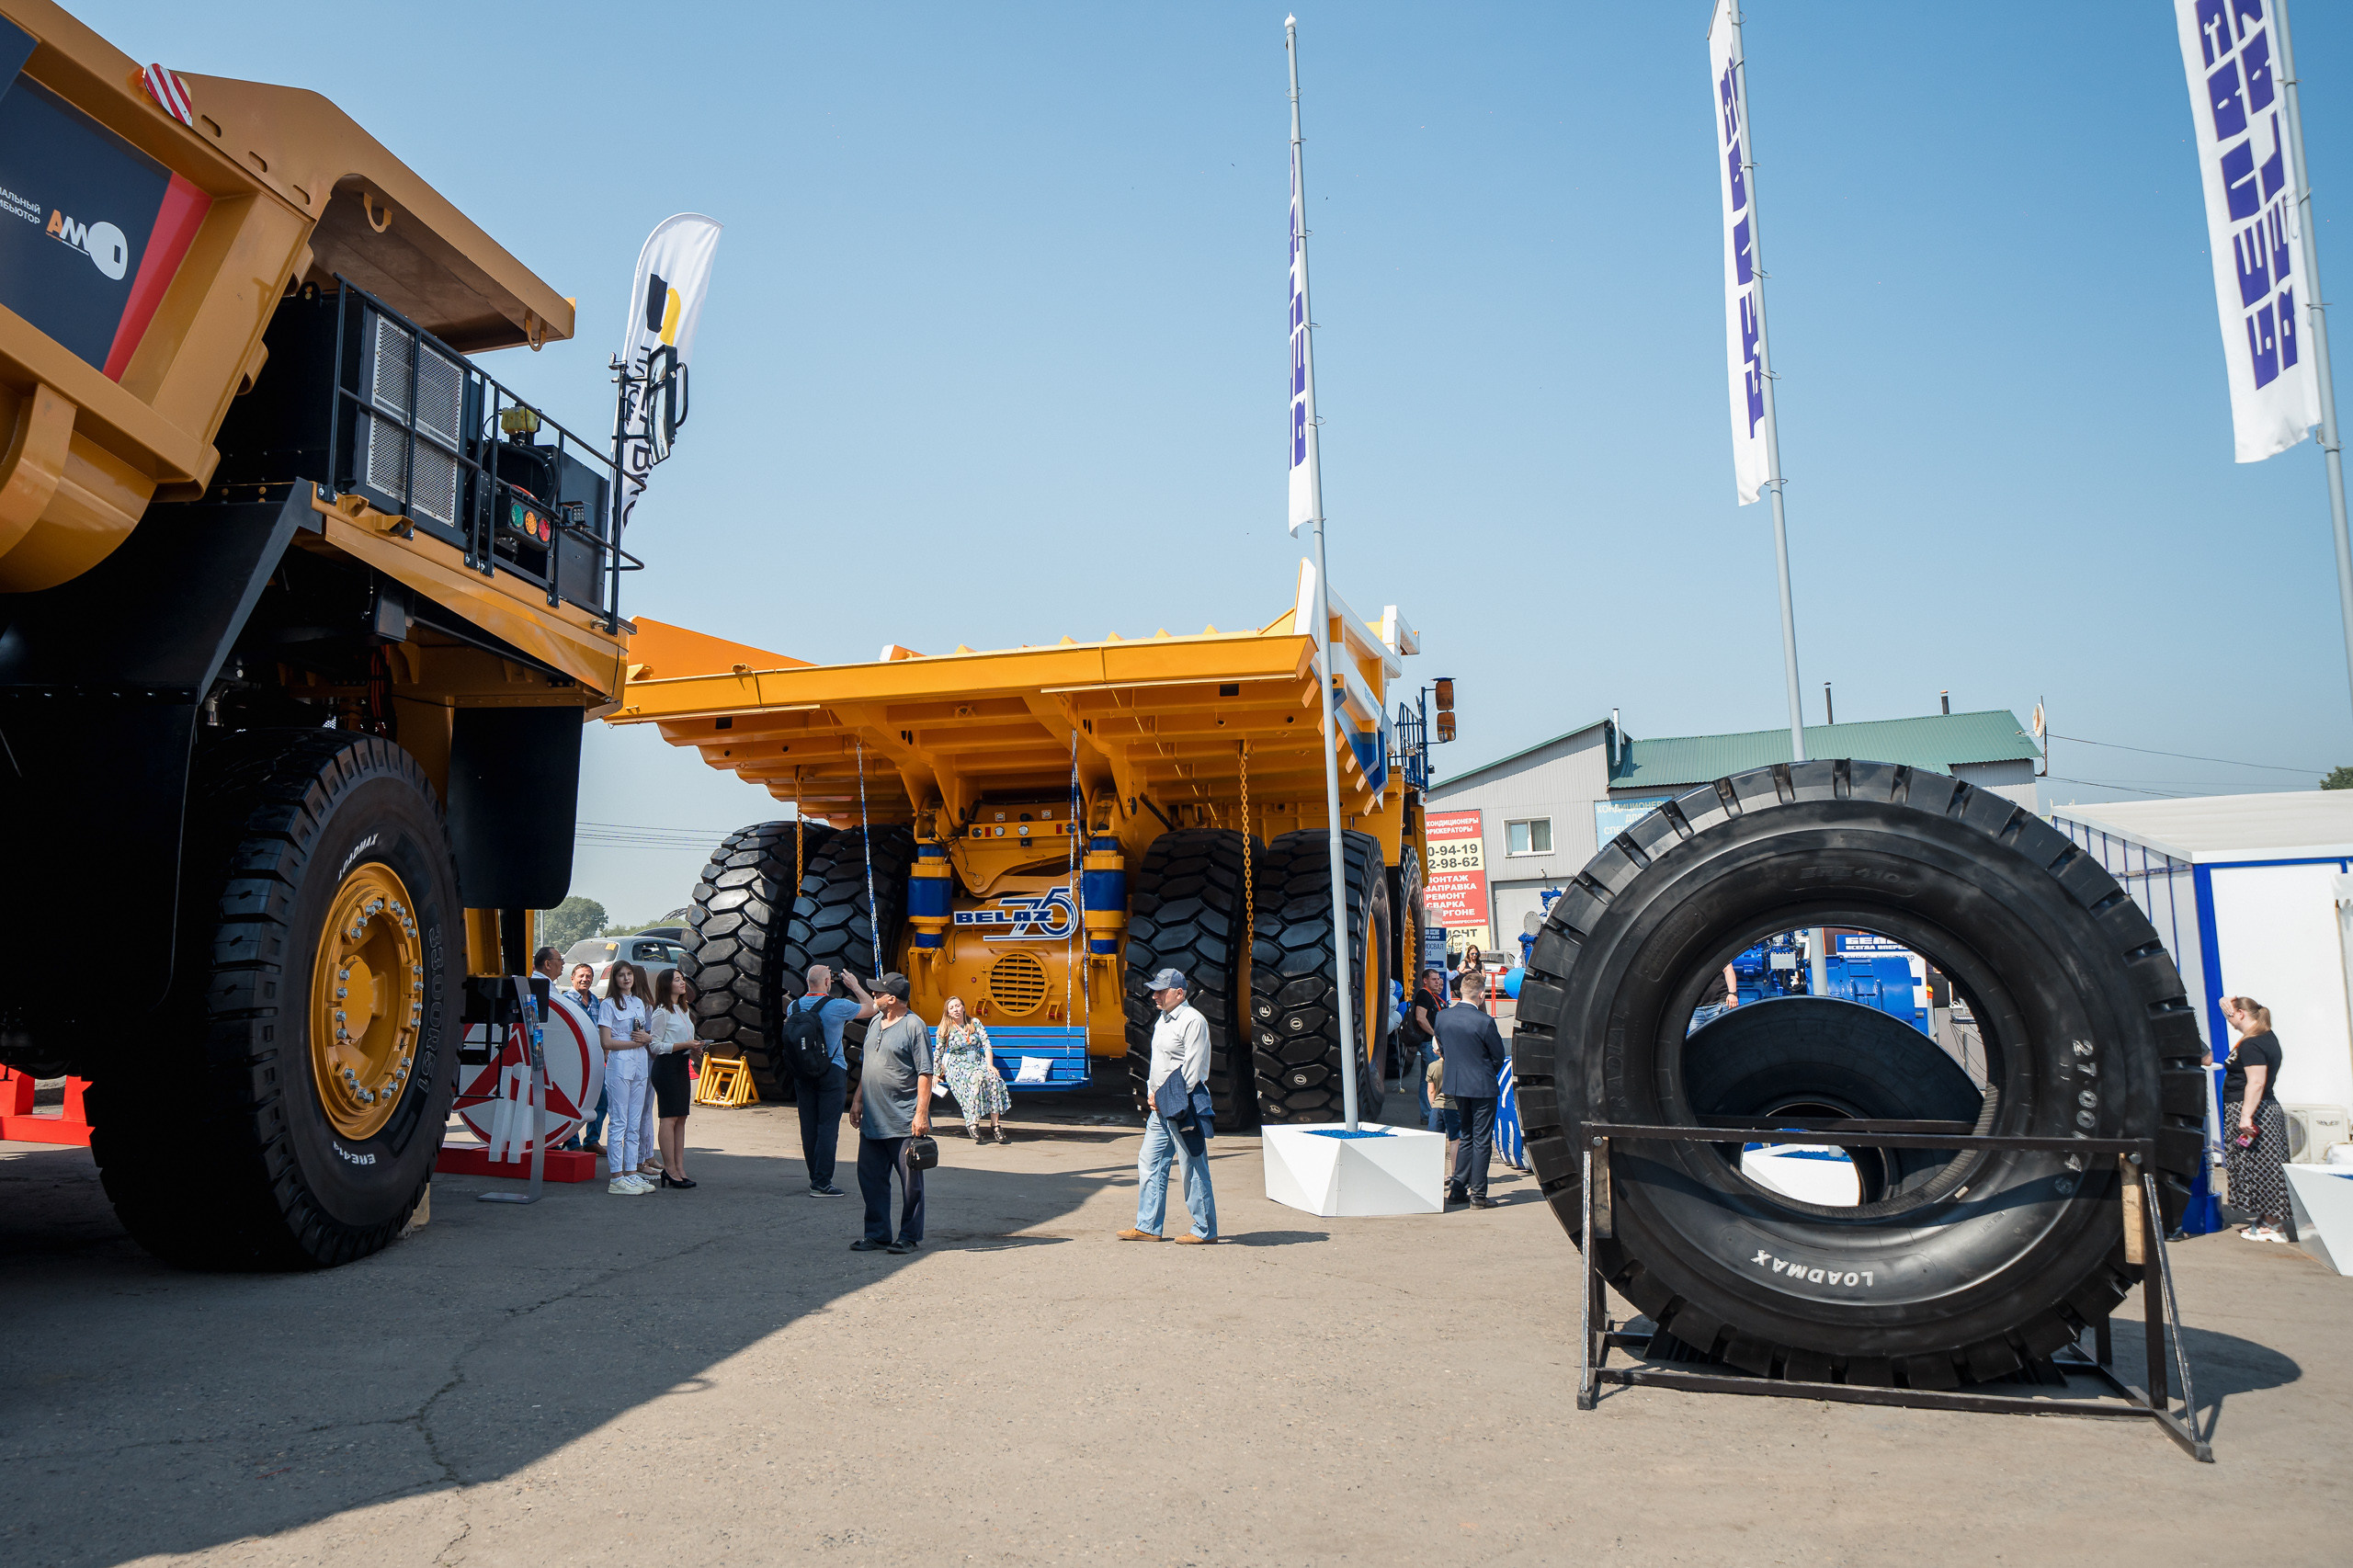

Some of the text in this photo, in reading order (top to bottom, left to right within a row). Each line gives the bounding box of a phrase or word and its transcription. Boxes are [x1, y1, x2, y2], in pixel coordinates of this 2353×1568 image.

[1597, 801, 1665, 814] КОНДИЦИОНЕР
[337, 833, 379, 882] LOADMAX
[1428, 857, 1479, 869] 2-98-62
[1426, 883, 1477, 892] ЗАПРАВКА
[1426, 892, 1466, 901] РЕМОНТ
[1427, 901, 1465, 909] СВАРКА
[954, 910, 1053, 925] BELAZ
[416, 923, 445, 1094] 33.00R51
[2054, 1039, 2098, 1194] 27.0049
[1750, 1249, 1874, 1287] LOADMAX
